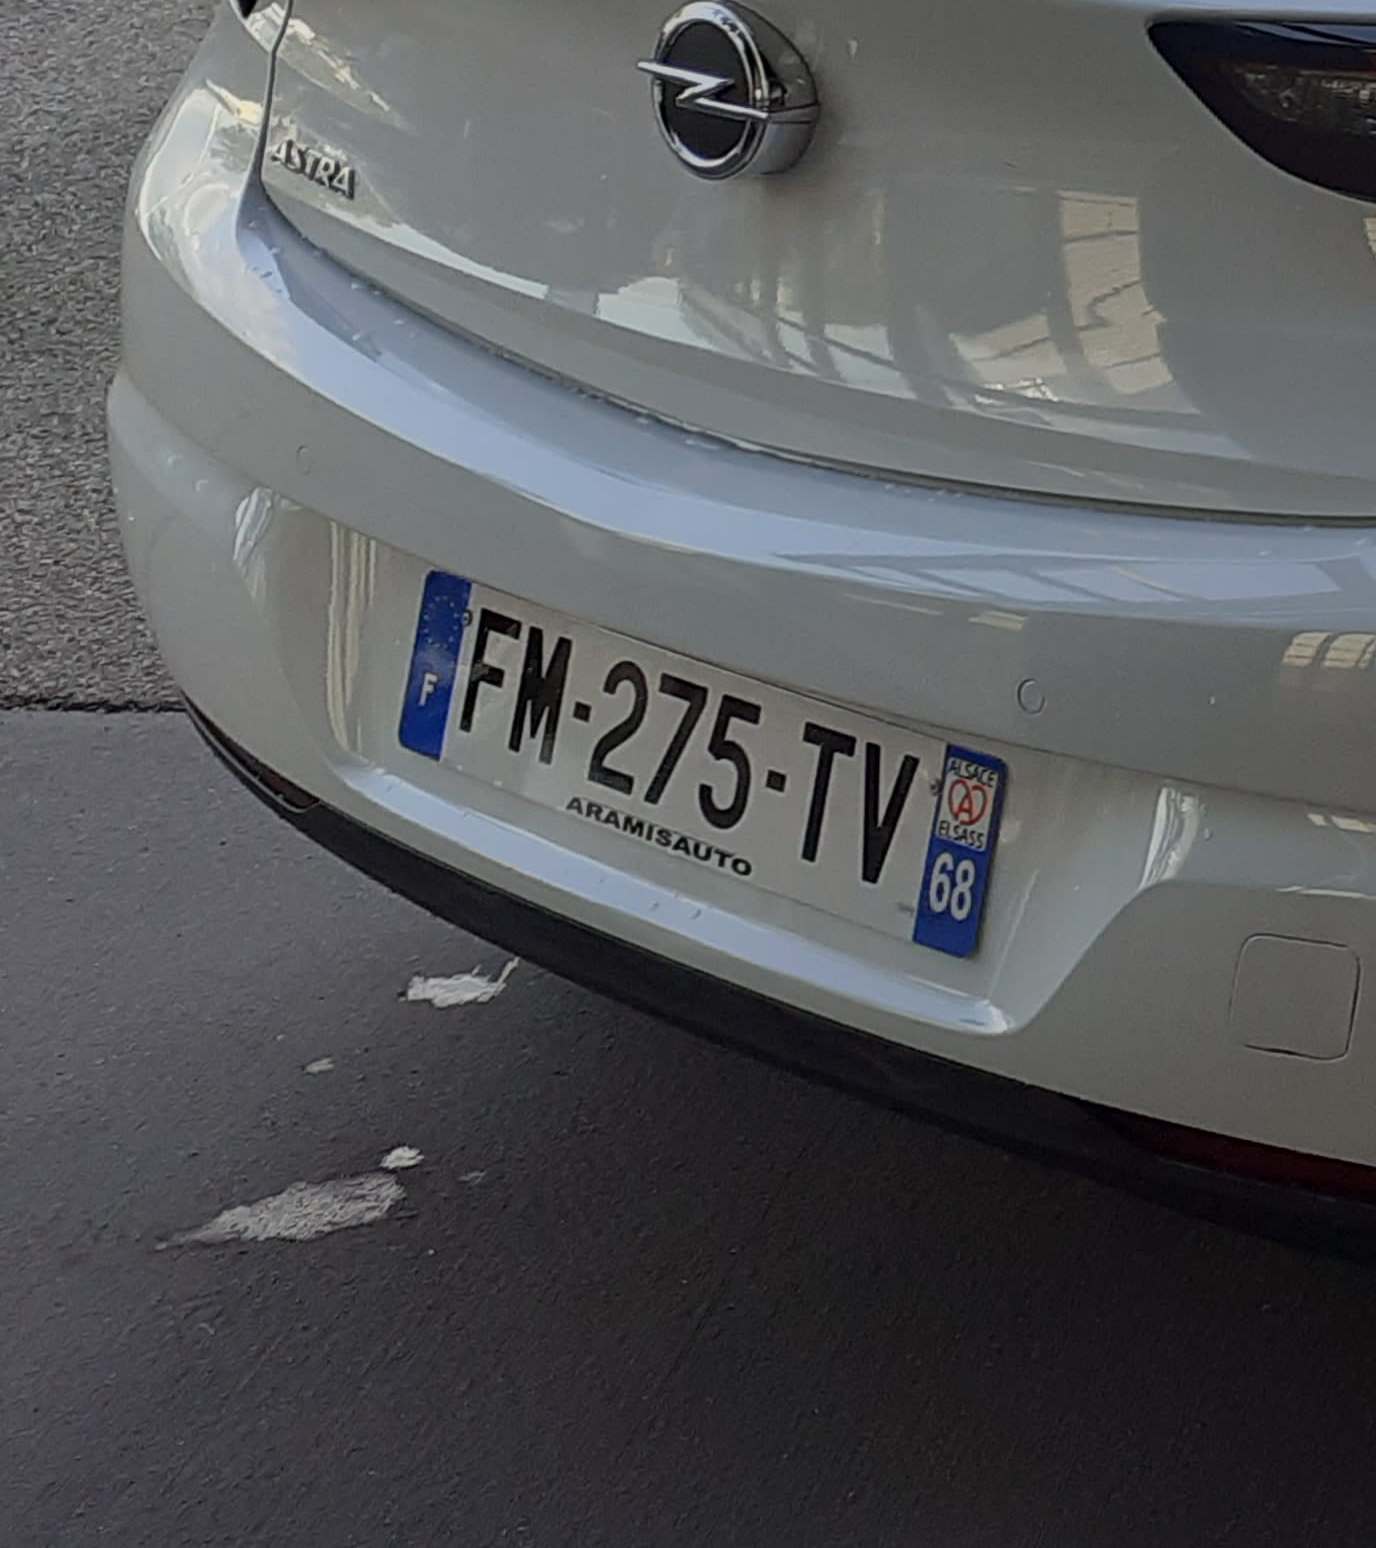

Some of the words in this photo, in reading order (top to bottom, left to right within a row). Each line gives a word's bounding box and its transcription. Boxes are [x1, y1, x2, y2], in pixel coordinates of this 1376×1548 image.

[270, 139, 355, 200] ASTRA
[418, 671, 439, 707] F
[459, 607, 920, 885] FM-275-TV
[949, 759, 998, 788] ALSACE
[564, 796, 753, 877] ARAMISAUTO
[938, 820, 985, 849] ELSASS
[929, 852, 976, 921] 68
